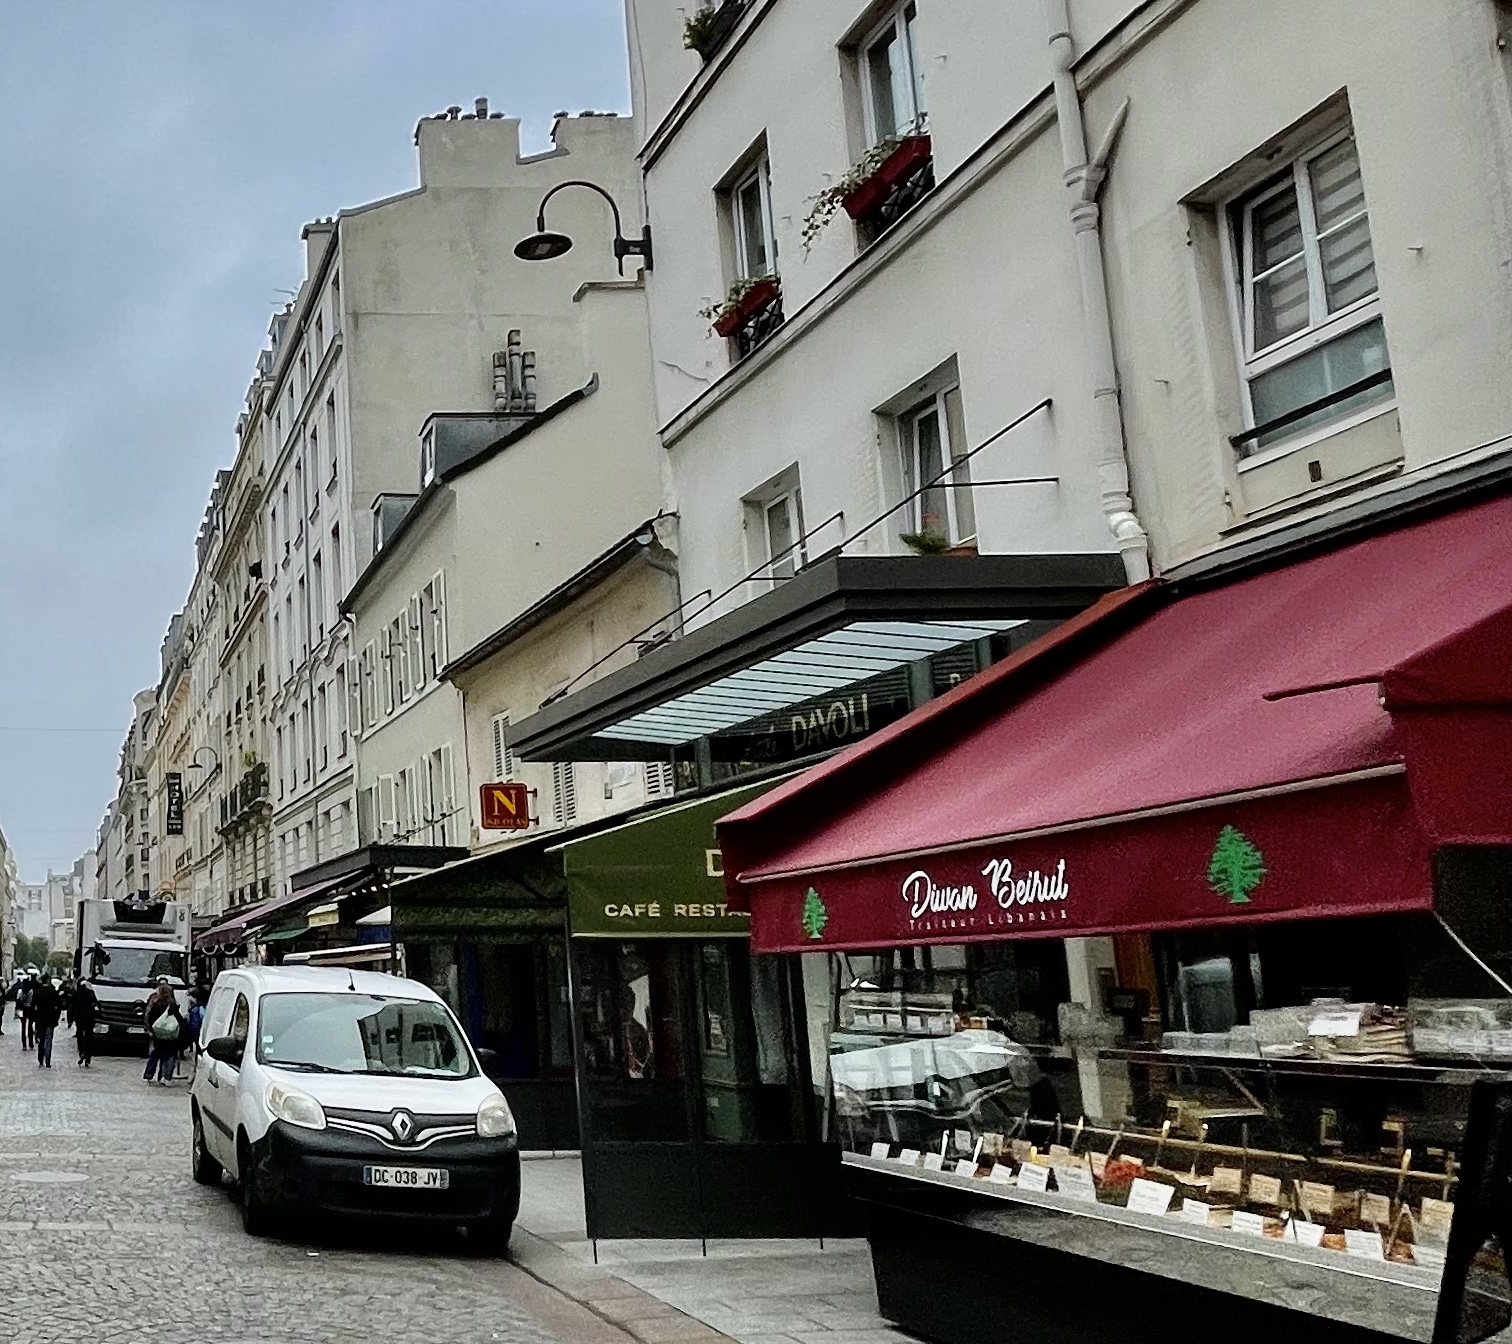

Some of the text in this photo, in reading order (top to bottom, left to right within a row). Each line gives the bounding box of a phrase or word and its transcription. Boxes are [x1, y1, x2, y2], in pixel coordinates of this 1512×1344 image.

[791, 693, 870, 751] DAVOLI
[492, 789, 517, 816] N
[604, 900, 661, 917] CAFÉ
[902, 858, 1069, 918] Diwan Beirut
